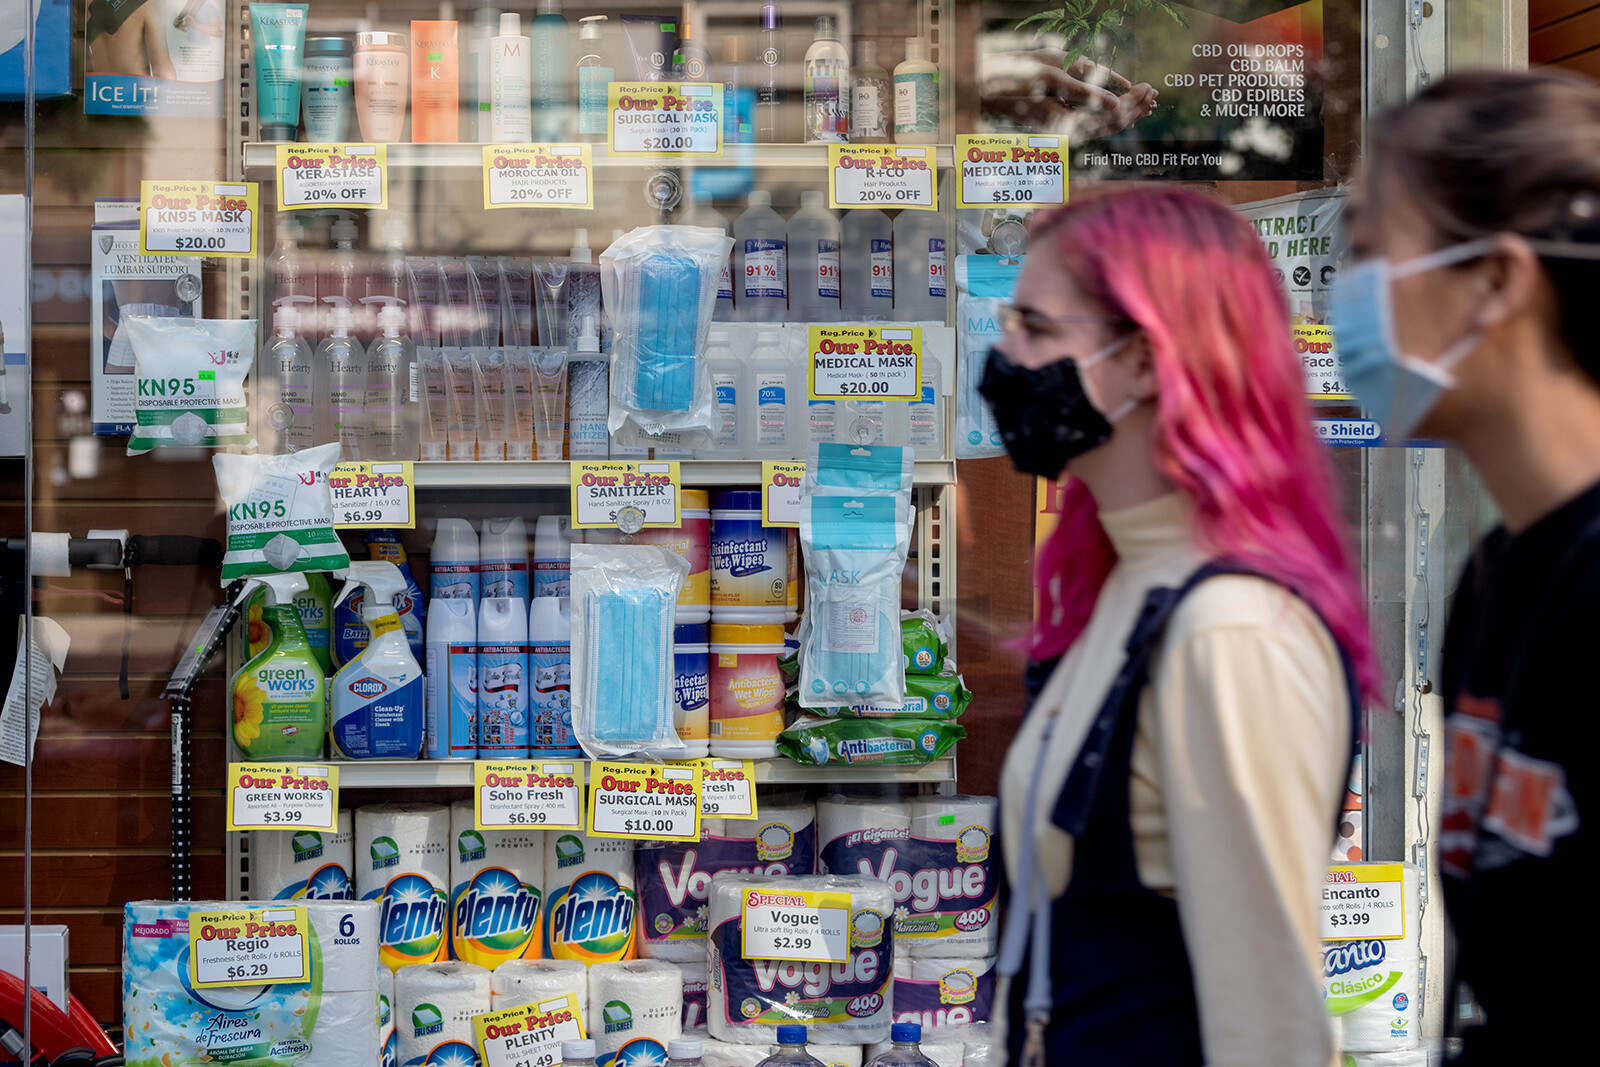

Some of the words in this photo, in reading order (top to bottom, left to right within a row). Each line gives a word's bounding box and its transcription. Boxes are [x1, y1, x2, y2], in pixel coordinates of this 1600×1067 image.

[1192, 44, 1222, 57] CBD
[1227, 44, 1251, 57] OIL
[1255, 44, 1304, 57] DROPS
[1230, 60, 1260, 72] CBD
[1265, 60, 1304, 71] BALM
[1164, 74, 1194, 87] CBD
[1200, 74, 1224, 86] PET
[1228, 74, 1304, 87] PRODUCTS
[1212, 89, 1242, 101] CBD
[1247, 89, 1304, 101] EDIBLES
[1200, 105, 1211, 116] &
[1216, 104, 1258, 116] MUCH
[1263, 104, 1305, 116] MORE
[618, 114, 679, 124] SURGICAL
[684, 113, 717, 122] MASK
[644, 137, 692, 151] $20.00
[1084, 154, 1108, 165] Find
[1111, 154, 1132, 165] The
[1136, 154, 1159, 165] CBD
[1163, 154, 1177, 165] Fit
[1181, 154, 1199, 165] For
[1202, 154, 1222, 165] You
[296, 168, 374, 180] KERASTASE
[499, 169, 558, 178] MOROCCAN
[866, 168, 904, 178] R+CO
[964, 166, 1023, 177] MEDICAL
[1027, 166, 1060, 176] MASK
[304, 190, 336, 200] 20%
[341, 189, 366, 199] OFF
[511, 189, 542, 199] 20%
[547, 189, 572, 198] OFF
[860, 191, 891, 201] 20%
[896, 190, 920, 199] OFF
[993, 190, 1032, 203] $5.00
[158, 211, 196, 222] KN95
[202, 211, 243, 222] MASK
[176, 237, 225, 250] $20.00
[1287, 237, 1330, 257] HERE
[105, 266, 144, 274] LUMBAR
[147, 266, 190, 274] SUPPORT
[746, 265, 775, 276] 91%
[820, 339, 859, 354] Our
[864, 339, 912, 355] Price
[281, 361, 311, 374] Hearty
[330, 361, 362, 374] Hearty
[368, 361, 397, 373] Hearty
[816, 358, 874, 369] MEDICAL
[879, 357, 913, 367] MASK
[139, 379, 195, 396] KN95
[840, 382, 888, 395] $20.00
[1331, 424, 1374, 435] Shield
[335, 487, 388, 498] HEARTY
[590, 486, 665, 497] SANITIZER
[230, 500, 286, 521] KN95
[344, 510, 382, 524] $6.99
[231, 522, 269, 531] DISPOSABLE
[272, 519, 312, 527] PROTECTIVE
[711, 540, 767, 555] Disinfectant
[715, 555, 730, 569] Wet
[730, 554, 764, 569] Wipes
[259, 669, 305, 682] green
[268, 679, 315, 691] works
[354, 683, 382, 692] CLOROX
[729, 677, 779, 689] Antibacterial
[734, 690, 751, 699] Wet
[754, 688, 776, 698] Wipes
[239, 775, 276, 788] Our
[281, 776, 328, 790] Price
[246, 793, 280, 801] GREEN
[490, 790, 522, 801] Soho
[528, 790, 563, 800] Fresh
[600, 795, 662, 805] SURGICAL
[665, 797, 696, 806] MASK
[264, 811, 302, 823] $3.99
[509, 813, 546, 825] $6.99
[625, 820, 673, 833] $10.00
[859, 849, 985, 910] Vogue
[455, 889, 539, 938] Plenty
[553, 892, 634, 944] Plenty
[771, 911, 819, 926] Vogue
[958, 909, 985, 925] 400
[339, 914, 355, 937] 6
[1331, 913, 1369, 927] $3.99
[135, 927, 170, 935] MEJORADO
[226, 938, 269, 953] Regio
[774, 938, 811, 950] $2.99
[203, 956, 235, 964] Freshness
[227, 964, 268, 980] $6.29
[1330, 973, 1383, 995] Clásico
[850, 994, 879, 1010] 400
[857, 1009, 875, 1017] HOJAS
[206, 1013, 248, 1030] Aires
[506, 1028, 555, 1050] PLENTY
[270, 1044, 309, 1056] Actifresh
